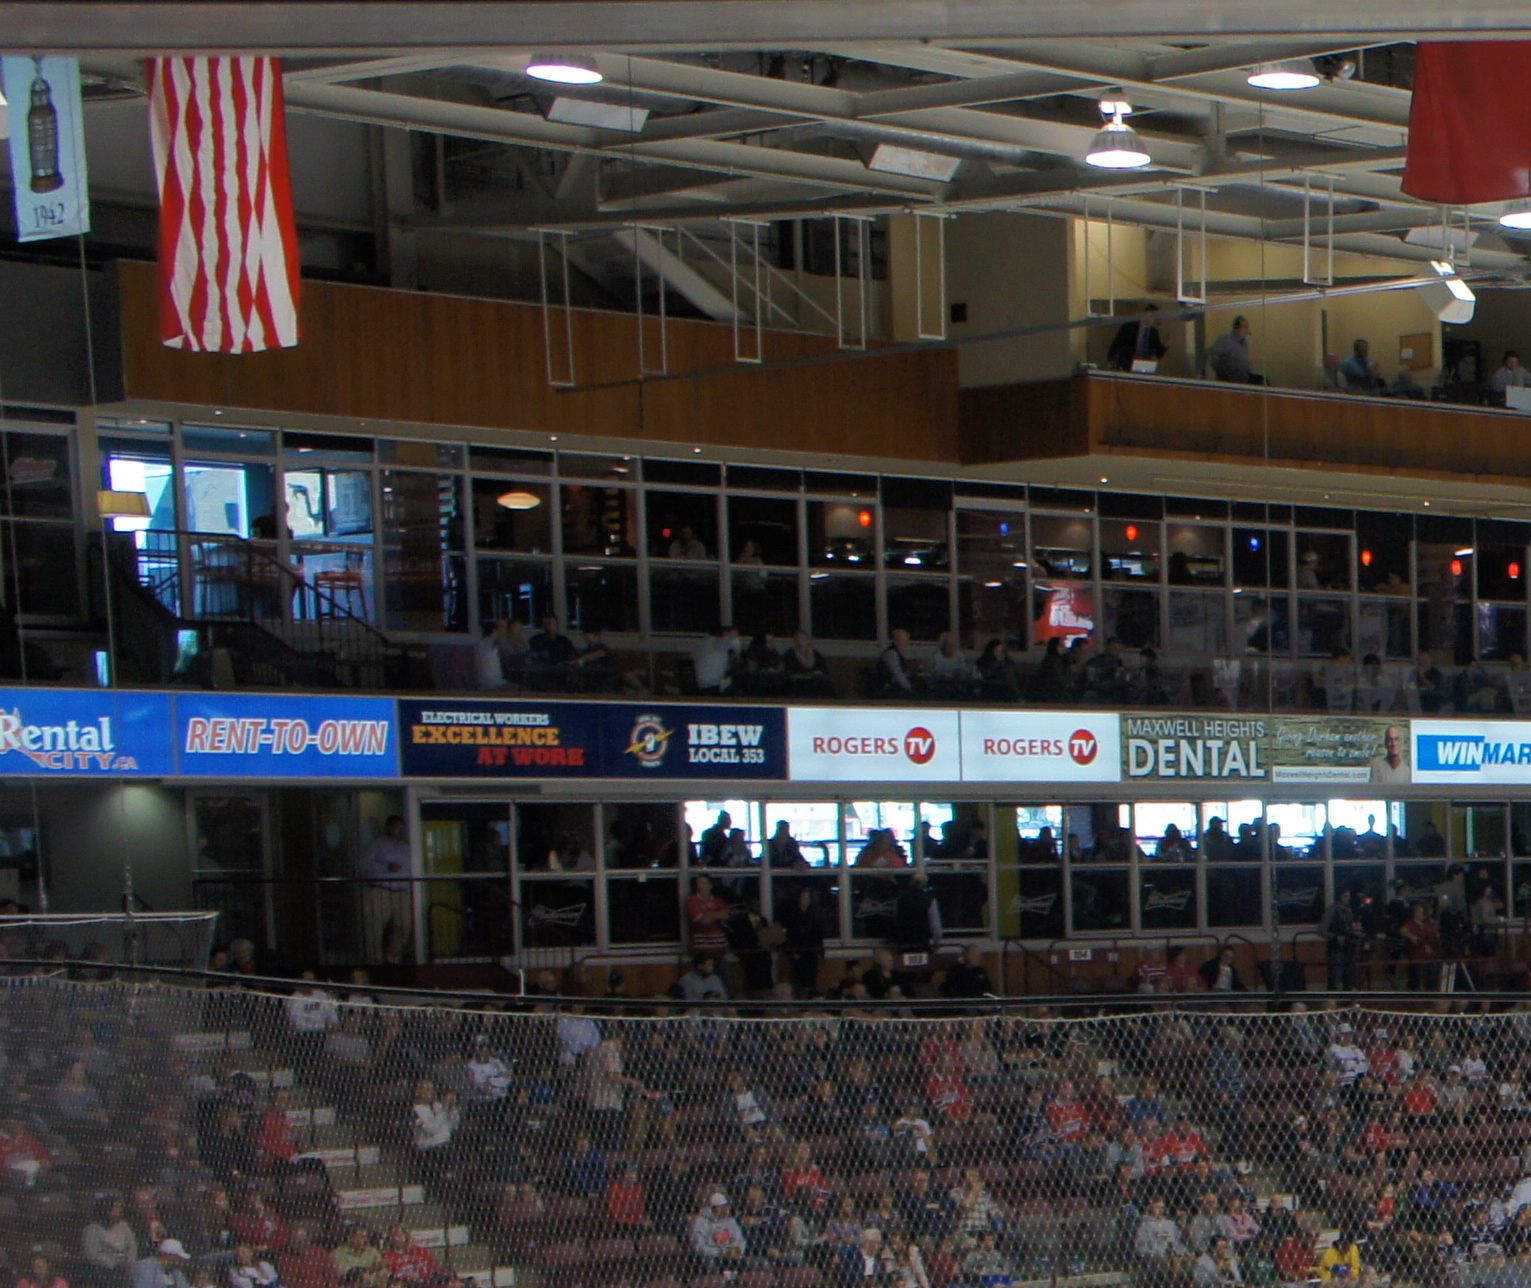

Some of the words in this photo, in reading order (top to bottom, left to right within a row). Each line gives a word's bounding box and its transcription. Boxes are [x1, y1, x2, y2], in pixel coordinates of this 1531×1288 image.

[421, 711, 494, 725] ELECTRICAL
[494, 713, 550, 726] WORKERS
[1126, 718, 1200, 737] MAXWELL
[1204, 720, 1265, 738] HEIGHTS
[0, 716, 116, 753] Rental
[185, 716, 390, 757] RENT-TO-OWN
[412, 725, 561, 746] EXCELLENCE
[687, 724, 764, 747] IBEW
[689, 747, 740, 764] LOCAL
[742, 748, 765, 764] 353
[812, 736, 899, 755] ROGERS
[906, 737, 935, 756] TV
[983, 738, 1064, 757] ROGERS
[1071, 739, 1097, 757] TV
[478, 747, 508, 766] AT
[513, 748, 585, 767] WORK
[1128, 740, 1265, 778] DENTAL
